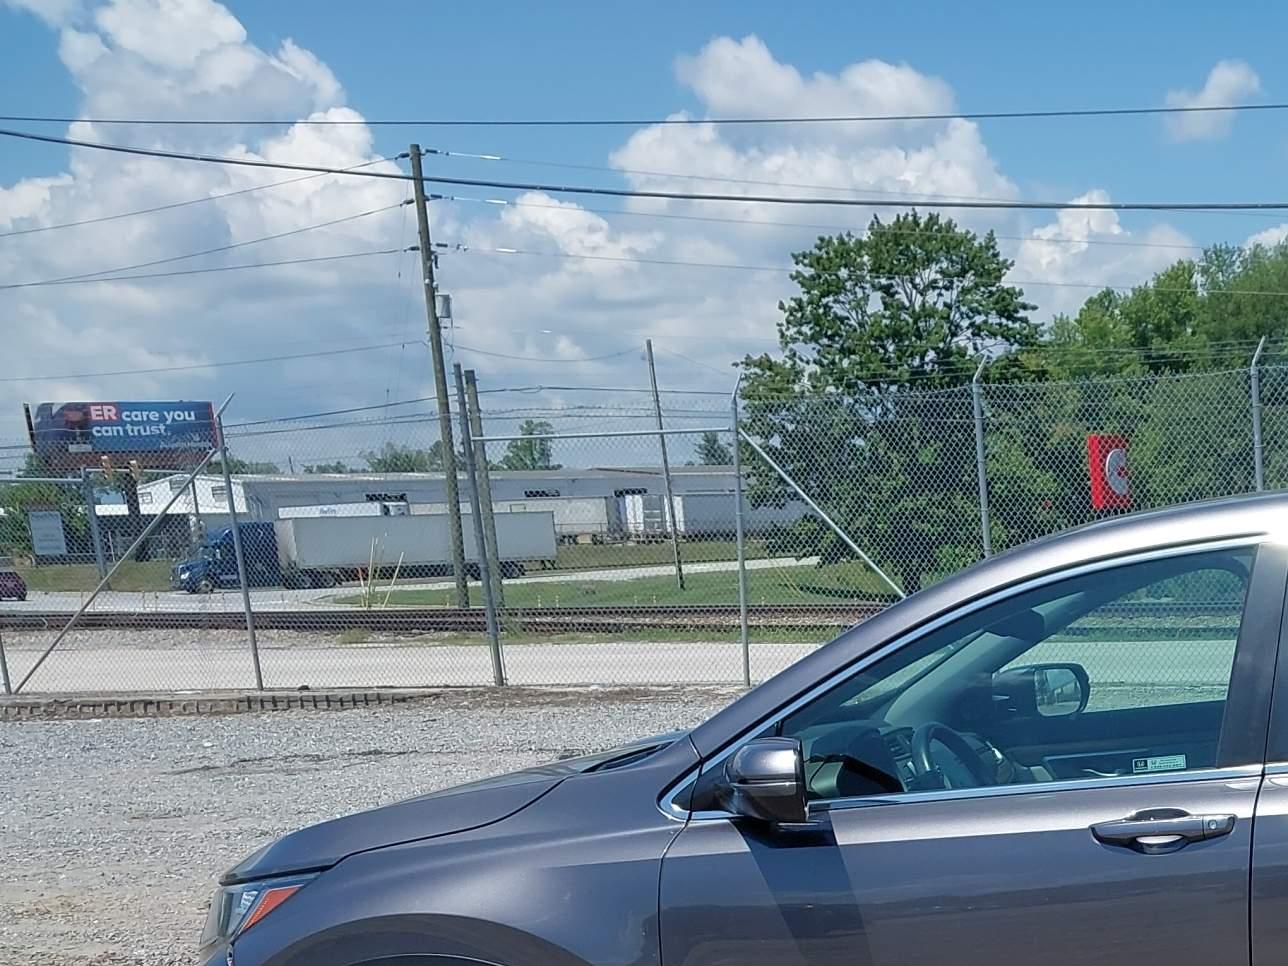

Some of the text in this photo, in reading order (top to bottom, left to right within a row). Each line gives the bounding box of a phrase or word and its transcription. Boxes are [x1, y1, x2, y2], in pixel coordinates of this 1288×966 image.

[90, 405, 196, 424] ER care you
[92, 425, 124, 437] can
